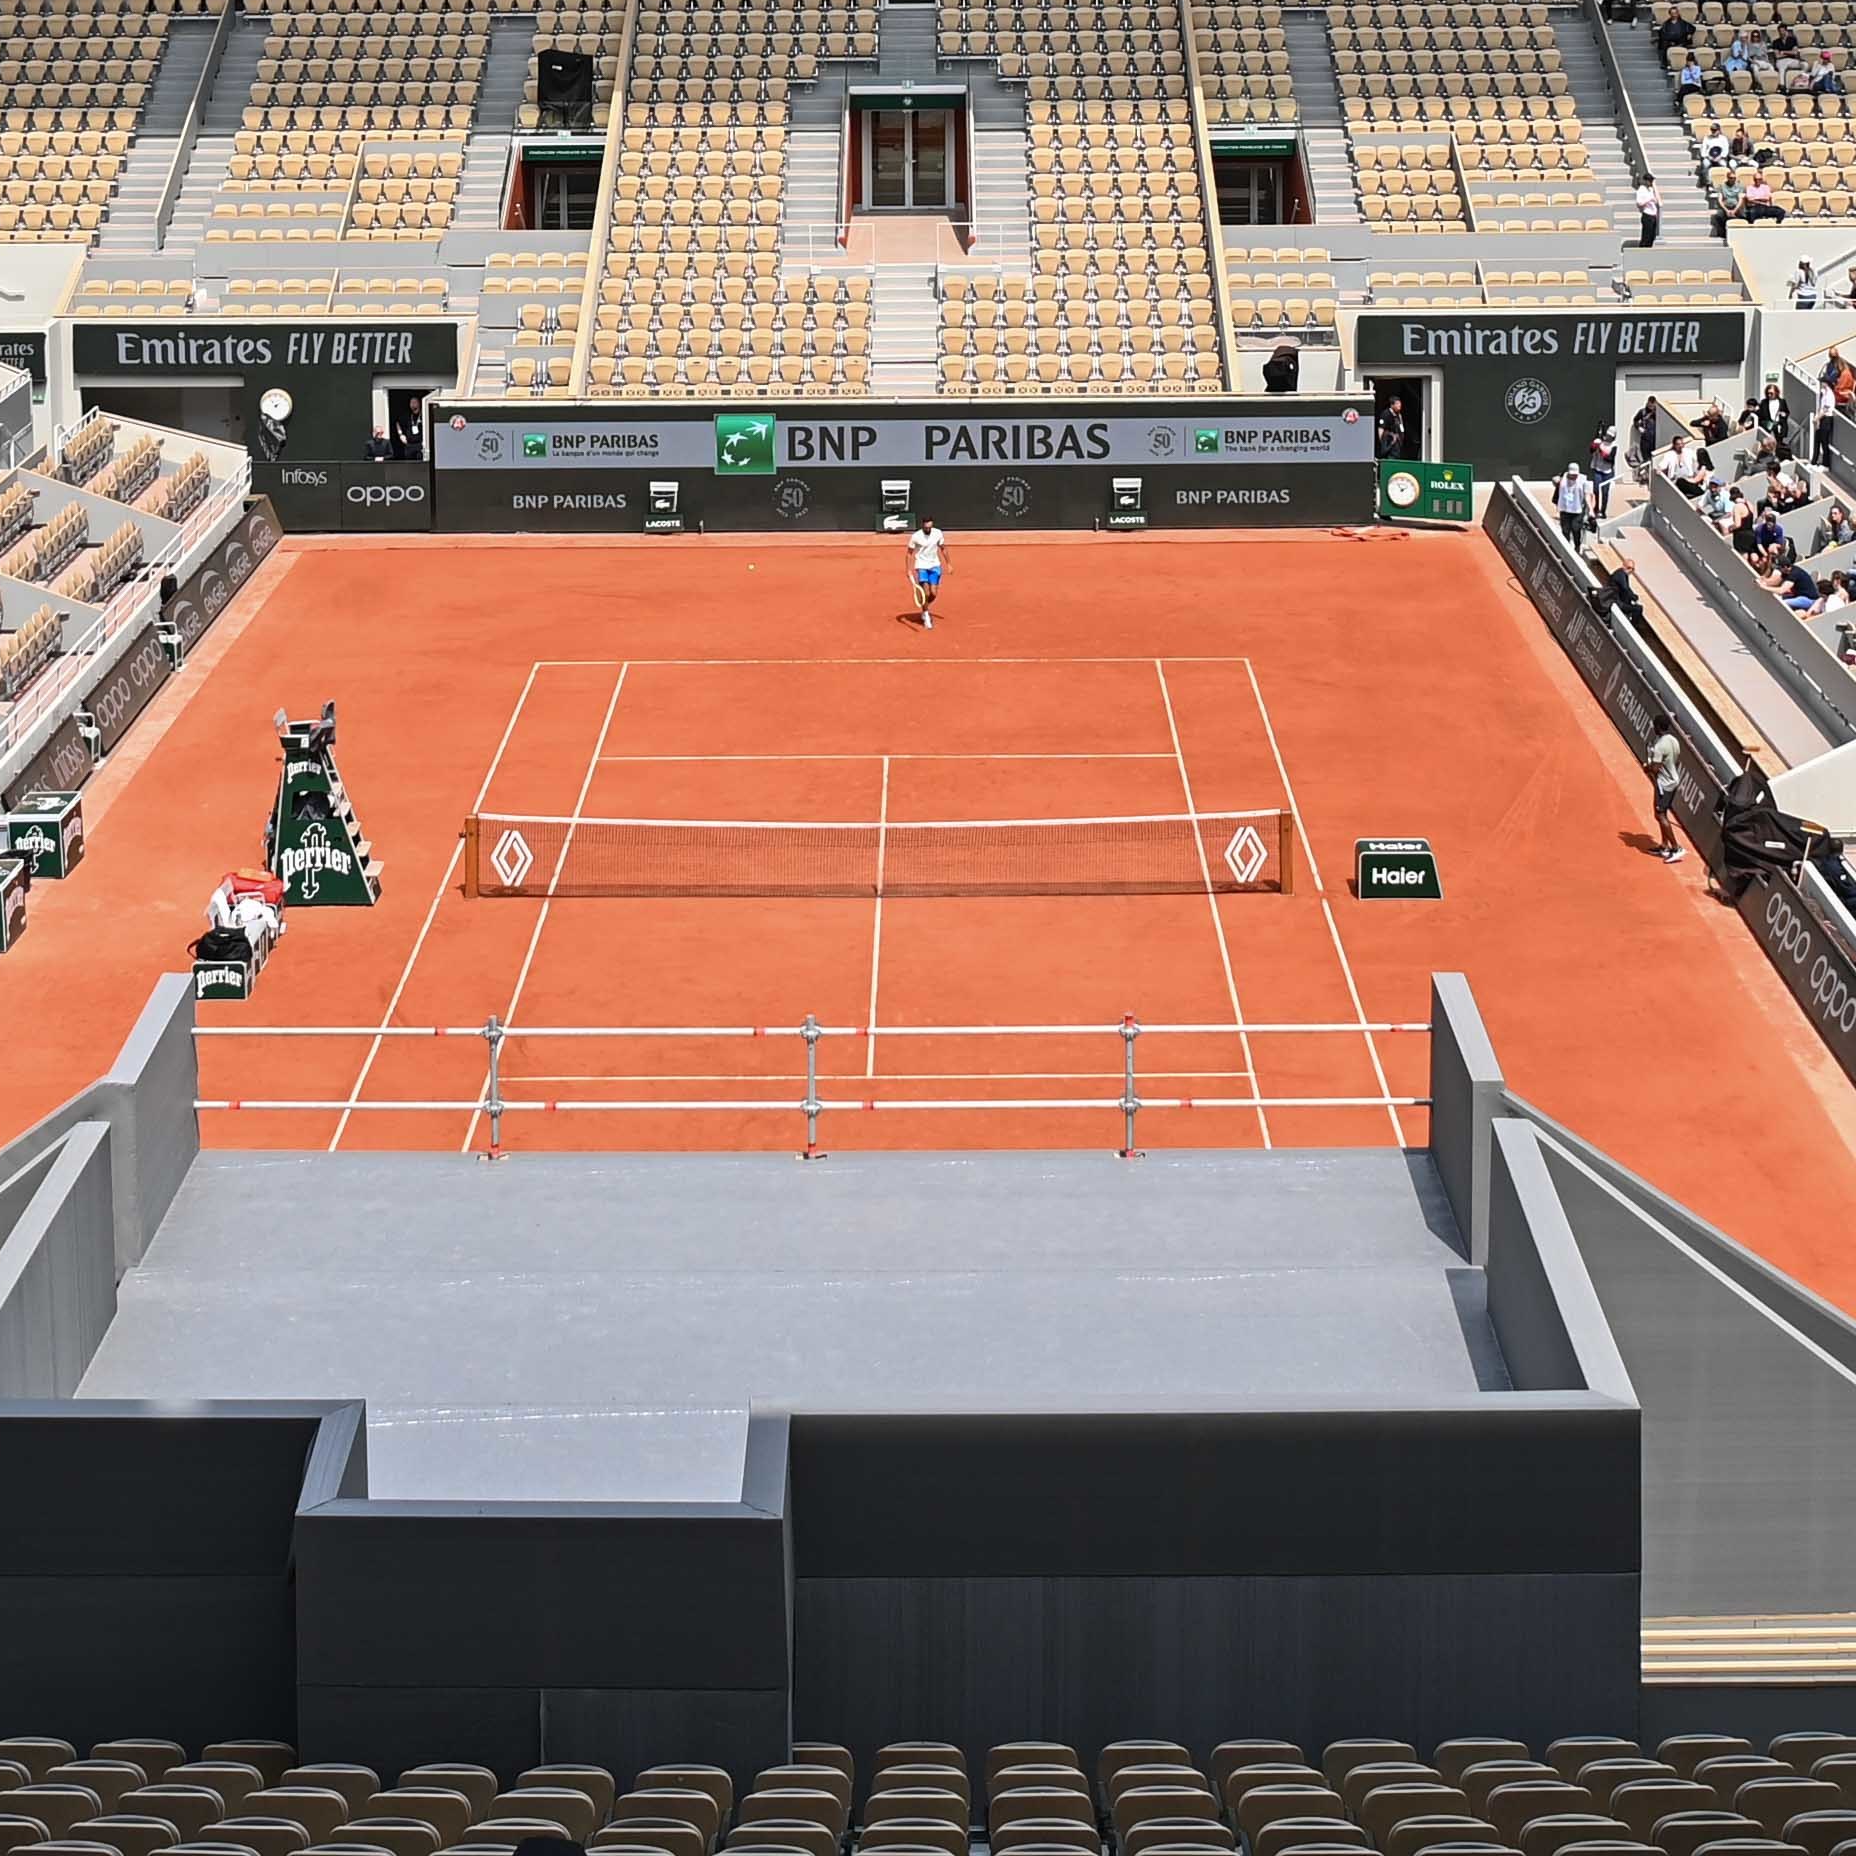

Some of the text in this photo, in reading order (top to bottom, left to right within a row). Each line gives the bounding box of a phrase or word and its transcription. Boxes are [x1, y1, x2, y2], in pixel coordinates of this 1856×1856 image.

[116, 331, 412, 365] Emirates FLY BETTER
[1401, 320, 1701, 357] Emirates FLY BETTER
[481, 438, 498, 454] 50
[553, 434, 658, 448] BNP PARIBAS
[787, 425, 877, 461] BNP
[925, 423, 1111, 460] PARIBAS
[1154, 433, 1171, 449] 50
[1224, 429, 1331, 444] BNP PARIBAS
[281, 469, 327, 486] Infosys
[1430, 481, 1464, 490] ROLEX
[347, 485, 424, 507] oppo
[512, 494, 627, 509] BNP PARIBAS
[782, 488, 803, 508] 50
[1002, 486, 1024, 506] 50
[1176, 490, 1291, 504] BNP PARIBAS
[645, 520, 681, 528] LACOSTE
[1110, 516, 1145, 525] LACOSTE
[130, 638, 162, 688] oppo
[96, 678, 132, 728] oppo
[1616, 683, 1654, 741] RENAULT
[287, 760, 322, 784] perrier
[280, 841, 352, 892] perrier
[1372, 867, 1426, 884] Haier
[1766, 891, 1810, 965] oppo
[197, 965, 243, 998] perrier
